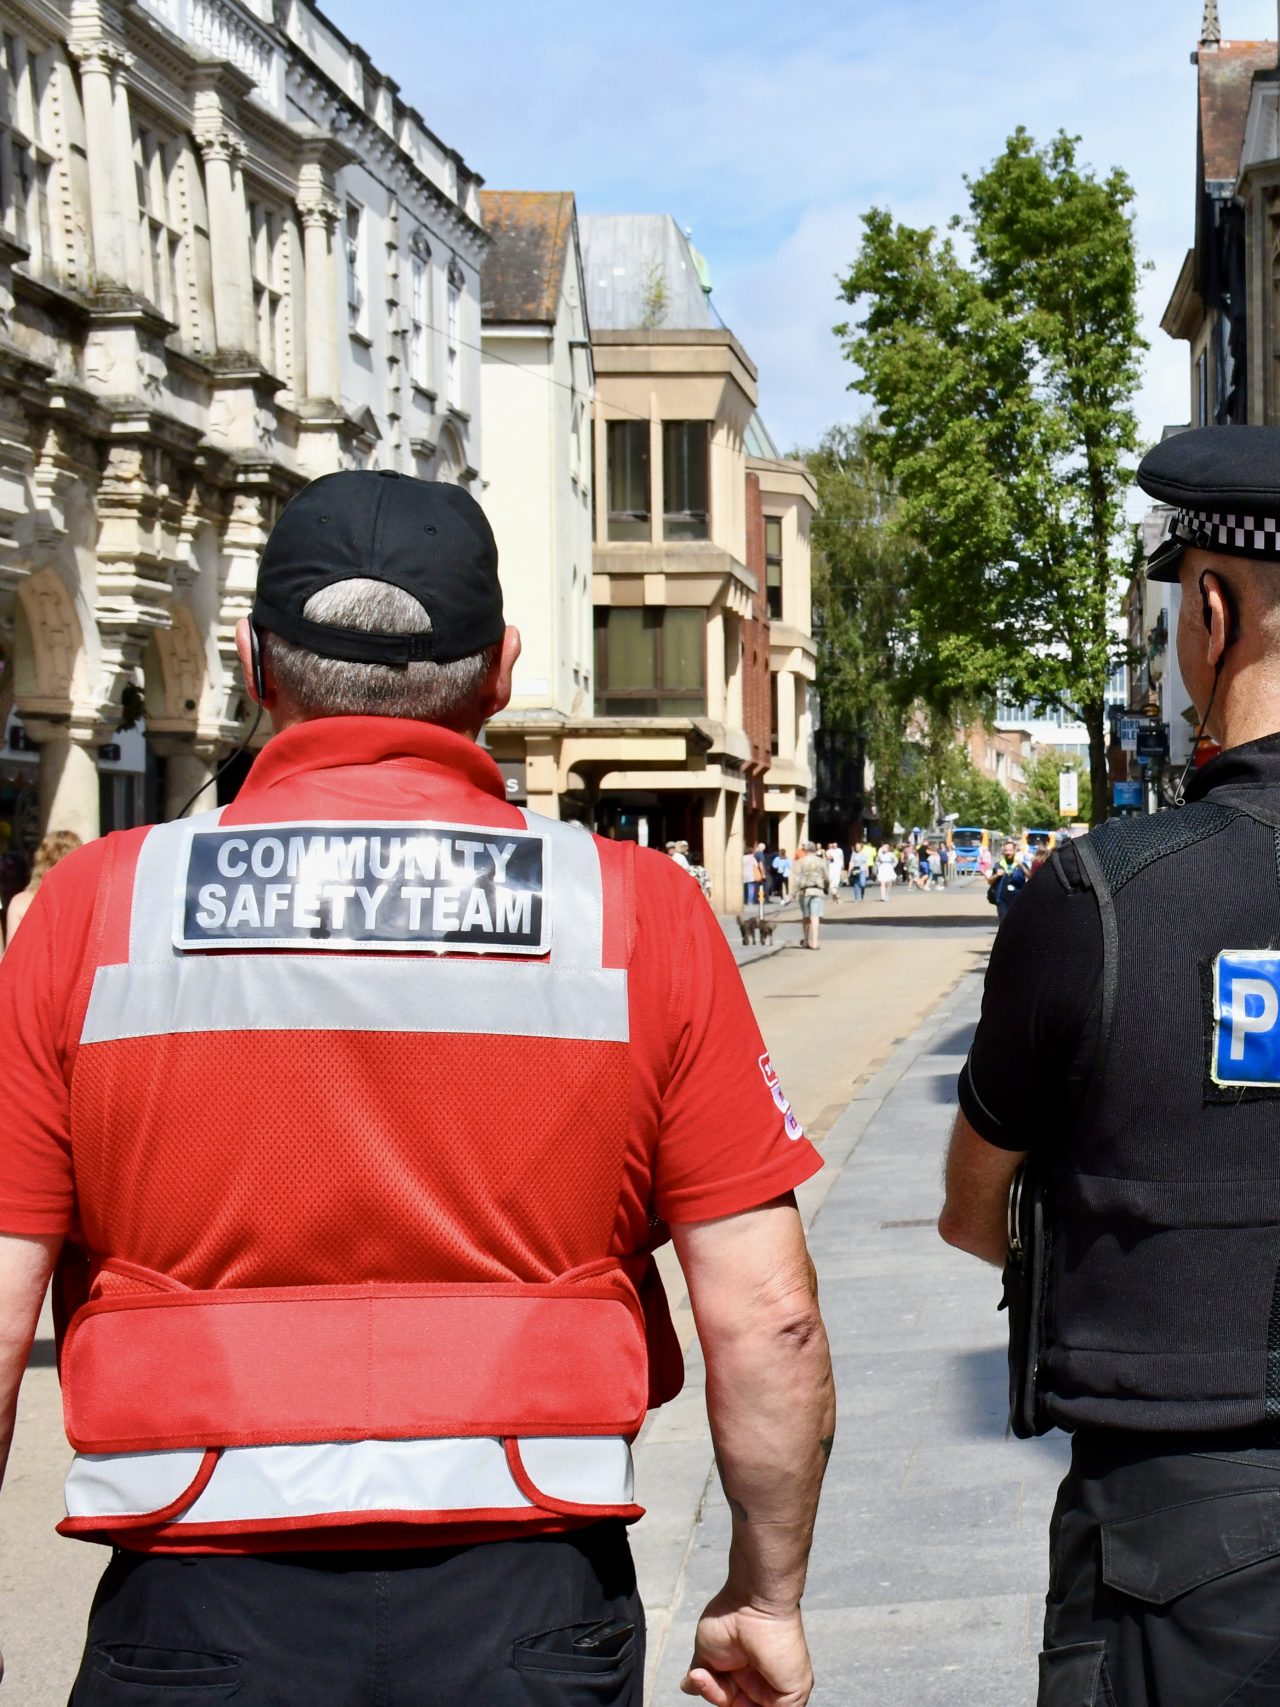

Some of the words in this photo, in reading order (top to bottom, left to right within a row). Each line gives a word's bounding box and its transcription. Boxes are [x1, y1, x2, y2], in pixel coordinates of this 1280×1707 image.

[1121, 730, 1137, 740] BLE
[217, 835, 517, 883] COMMUNITY
[195, 883, 389, 930] SAFETY
[401, 886, 532, 934] TEAM
